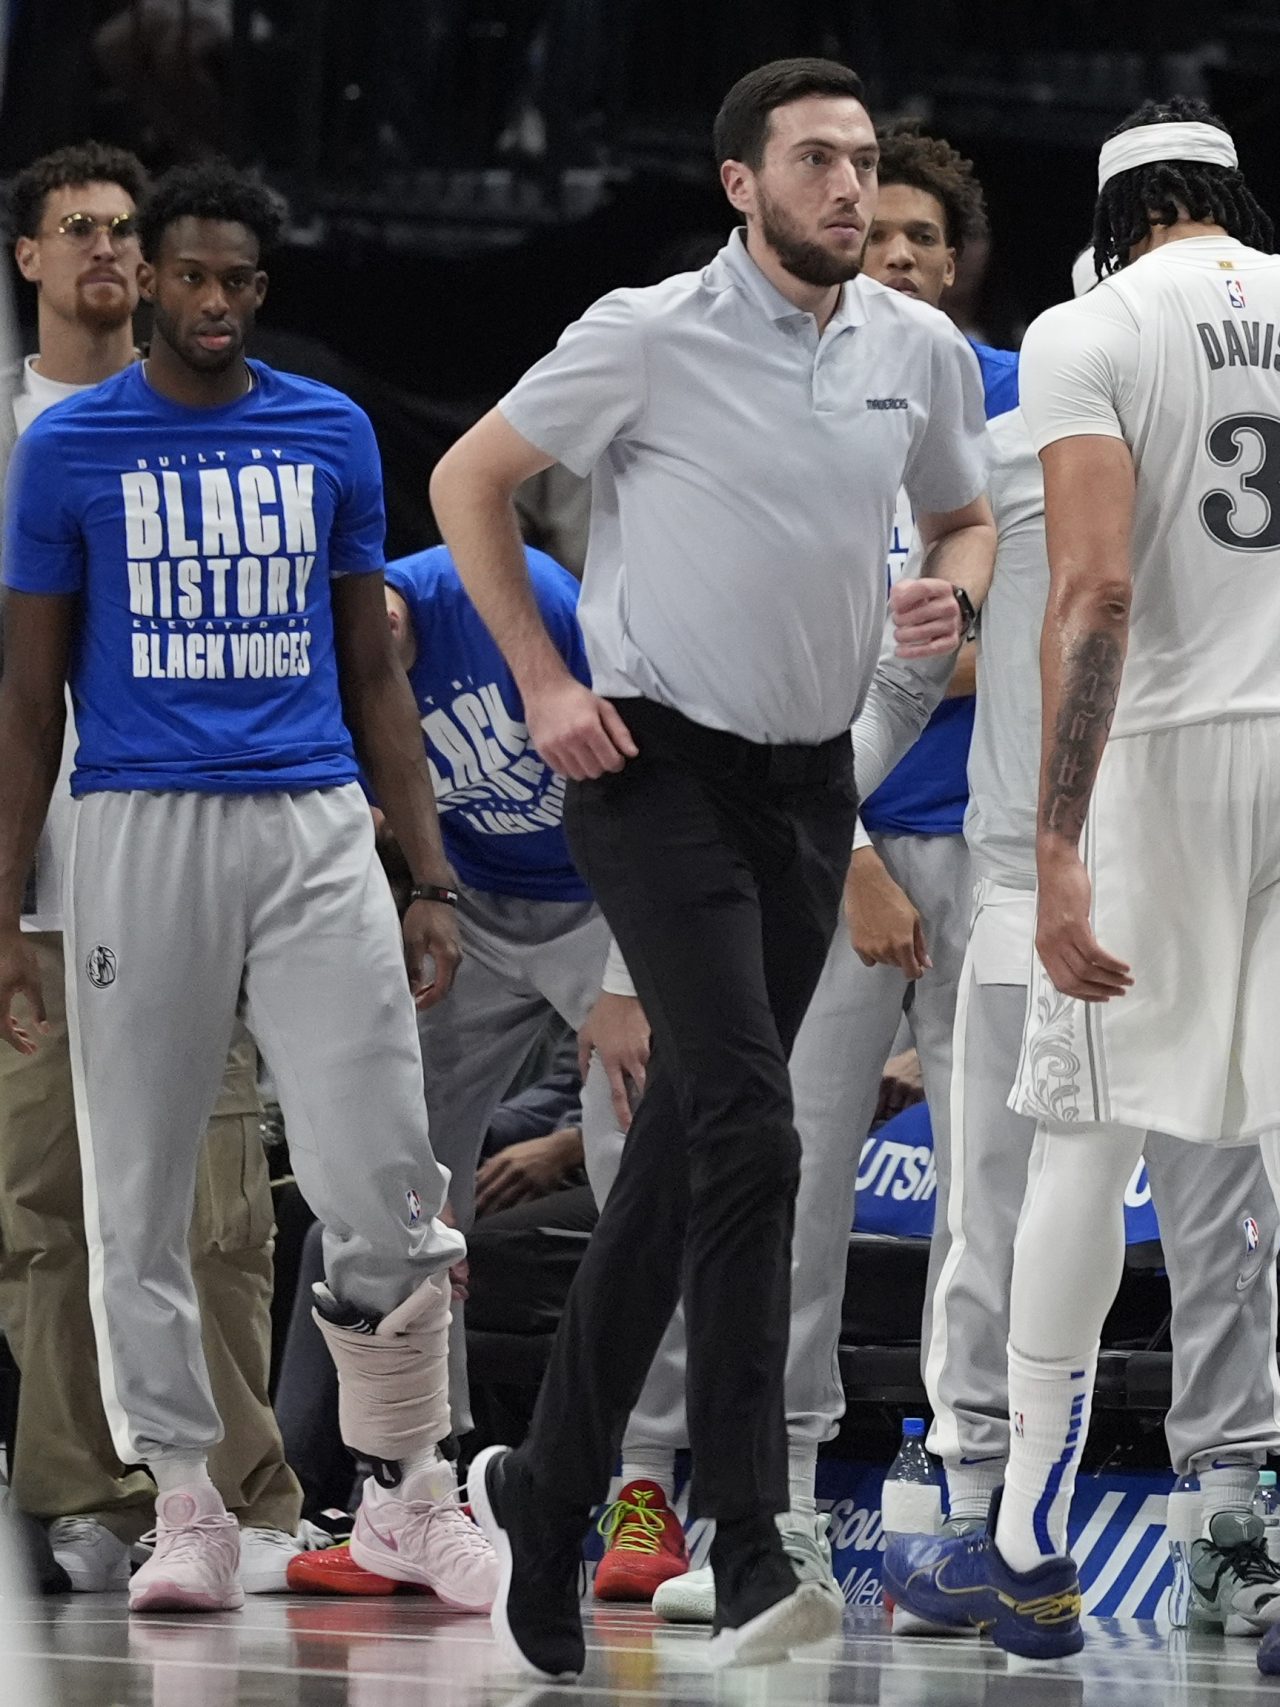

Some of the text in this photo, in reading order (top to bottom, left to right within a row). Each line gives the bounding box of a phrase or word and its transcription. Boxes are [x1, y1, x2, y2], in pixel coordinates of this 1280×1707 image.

[137, 448, 282, 469] BUILT BY
[121, 464, 317, 559] BLACK
[127, 555, 315, 619] HISTORY
[133, 618, 309, 630] ELEVATED BY
[132, 631, 312, 679] BLACK VOICES
